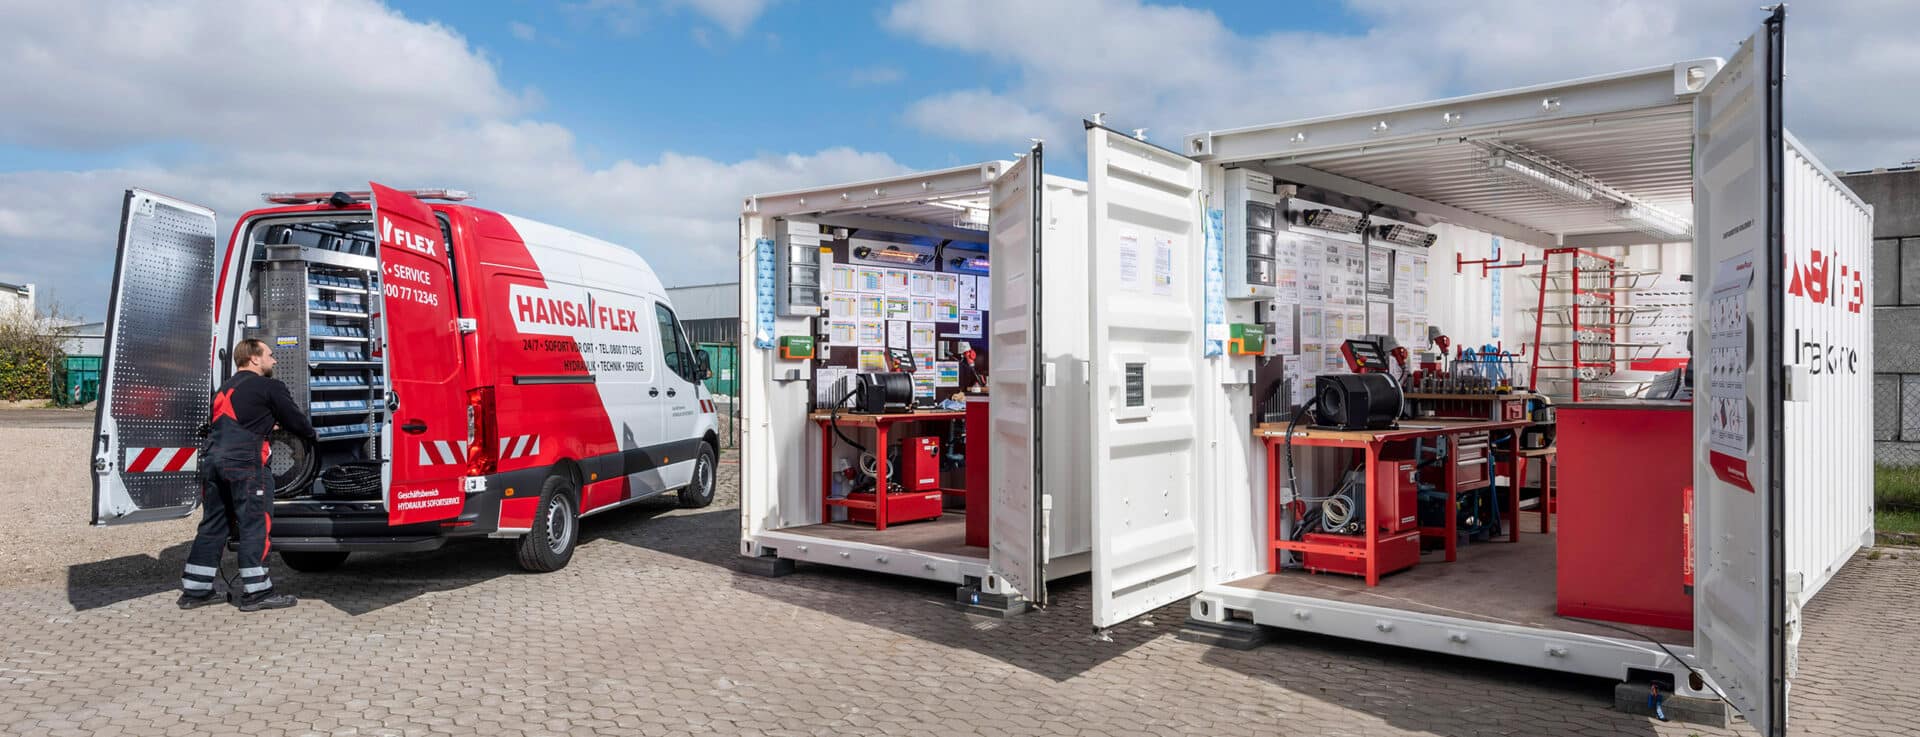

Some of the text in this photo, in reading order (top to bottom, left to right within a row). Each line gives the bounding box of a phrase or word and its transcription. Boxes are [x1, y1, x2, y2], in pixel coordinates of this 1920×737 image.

[394, 228, 436, 256] FLEX
[393, 264, 431, 285] SERVICE
[400, 286, 411, 301] 77
[413, 289, 438, 306] 12345
[516, 294, 639, 333] HANSA FLEX
[522, 339, 539, 351] 24/7
[544, 340, 569, 352] SOFORT
[570, 341, 582, 352] VOR
[583, 342, 594, 353] ORT
[564, 360, 644, 372] HYDRAULIK TECHNIK SERVICE
